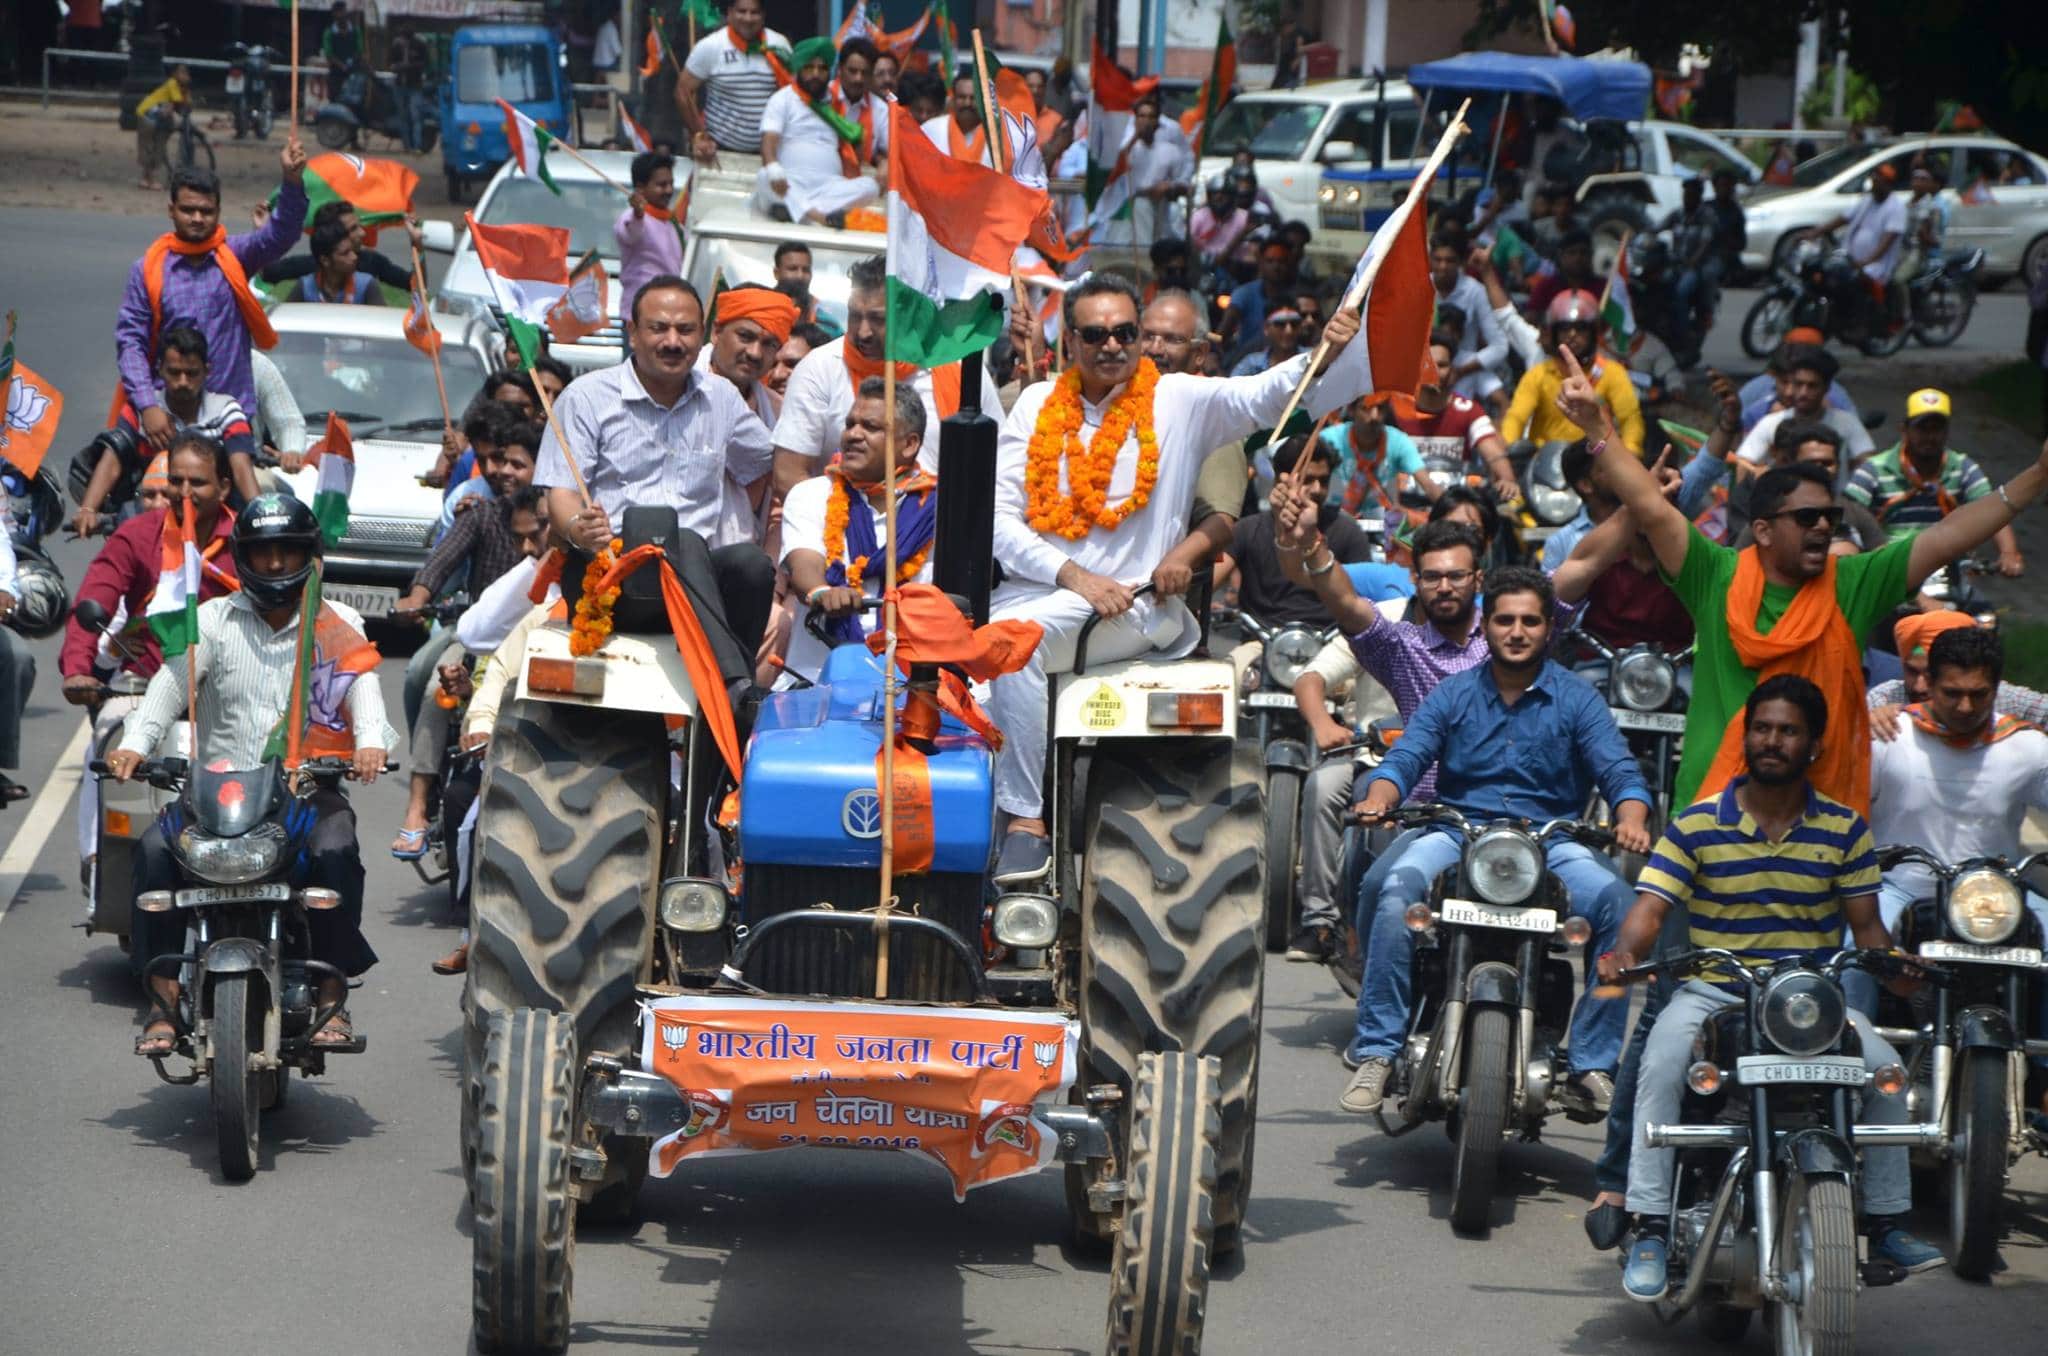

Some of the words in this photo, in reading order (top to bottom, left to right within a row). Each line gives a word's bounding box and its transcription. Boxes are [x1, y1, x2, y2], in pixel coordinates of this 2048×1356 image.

[696, 1022, 818, 1061] भारतीय
[835, 1033, 932, 1064] जनता
[949, 1034, 1026, 1071] पार्टी
[745, 1100, 799, 1124] जन
[815, 1089, 894, 1127] चेतना
[903, 1104, 970, 1130] यात्रा
